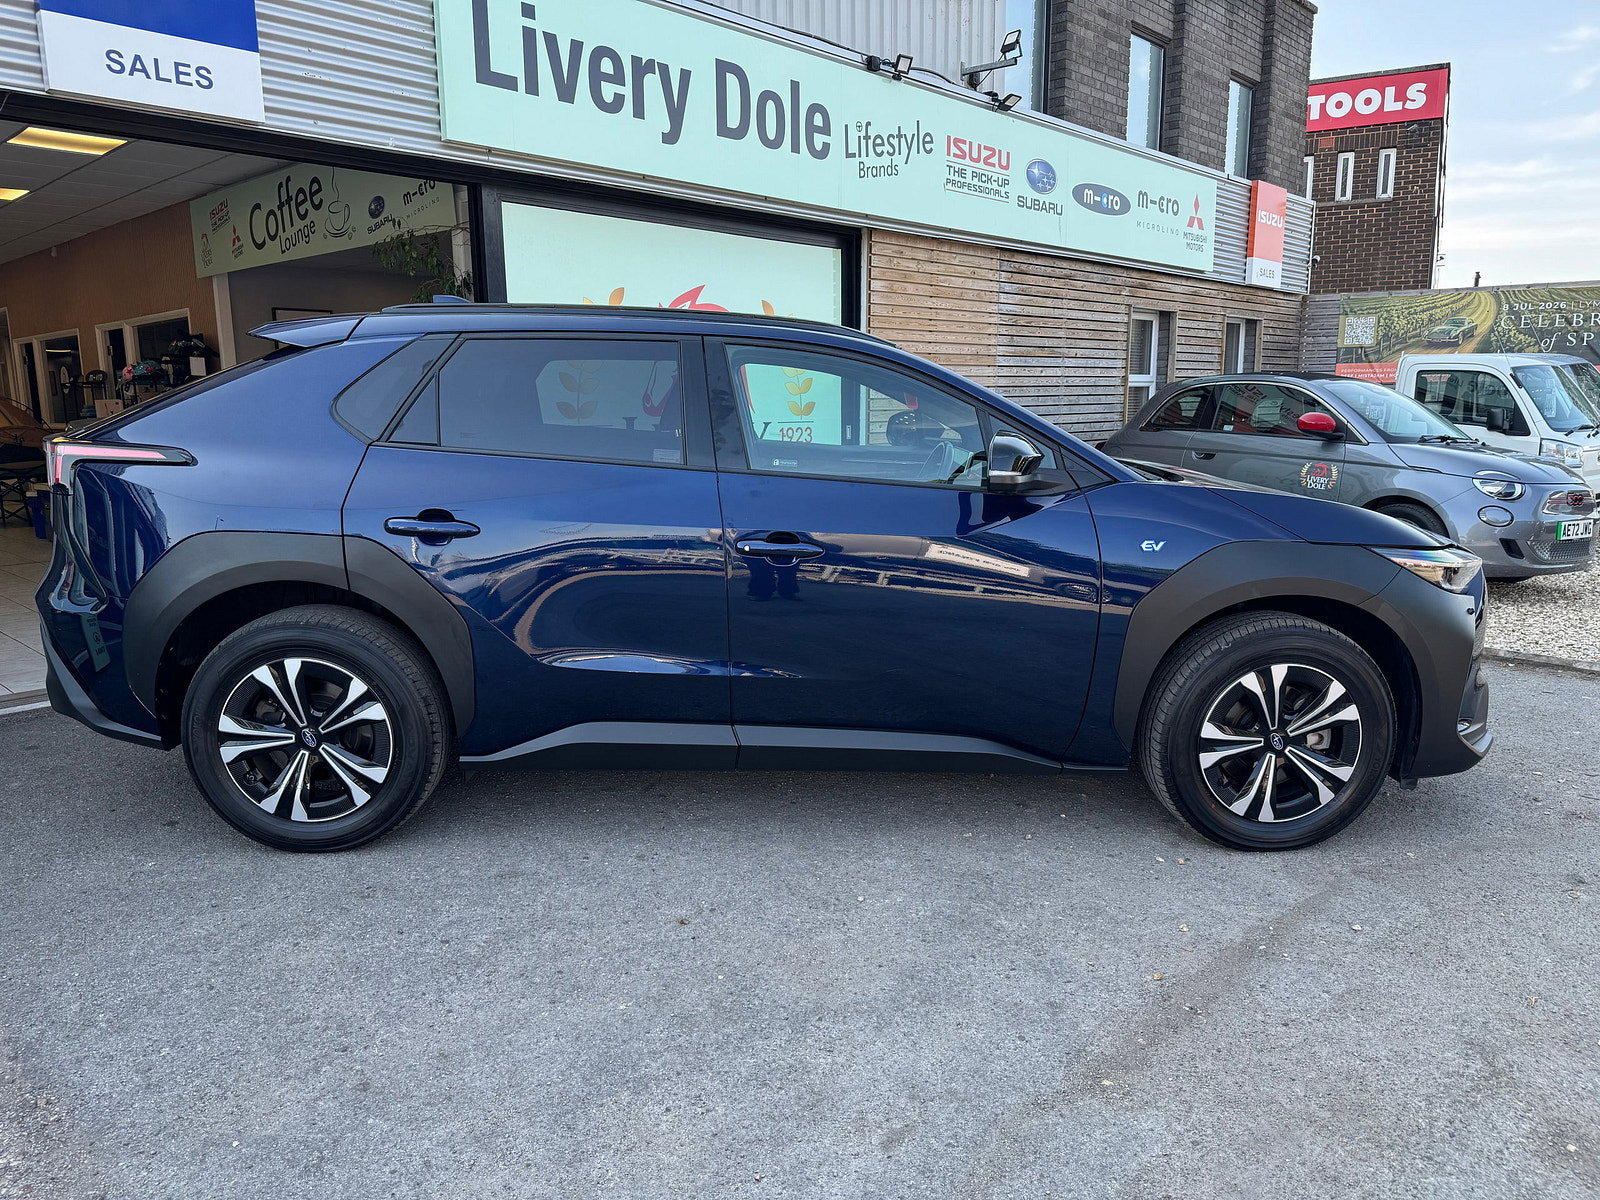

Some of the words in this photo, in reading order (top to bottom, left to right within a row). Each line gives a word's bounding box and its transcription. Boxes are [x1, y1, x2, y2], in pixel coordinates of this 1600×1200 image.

[105, 49, 214, 90] SALES
[472, 0, 692, 145] Livery
[715, 58, 831, 160] Dole
[1307, 82, 1427, 120] TOOLS
[844, 120, 934, 165] Lifestyle
[946, 135, 1011, 171] ISUZU
[858, 158, 899, 179] Brands
[946, 164, 967, 179] THE
[971, 171, 1010, 189] PICK-UP
[946, 178, 1010, 199] PROFESSIONALS
[209, 198, 229, 220] ISUZU
[249, 175, 324, 250] Coffee
[1017, 195, 1063, 216] SUBARU
[367, 213, 393, 235] SUBARU
[1136, 220, 1180, 236] MICROLINO
[1257, 210, 1283, 228] ISUZU
[279, 220, 316, 254] Lounge
[1183, 231, 1208, 244] MITSUBISHI
[1186, 242, 1204, 253] MOTORS
[1258, 267, 1275, 280] SALES
[1513, 302, 1535, 311] JUL
[1538, 301, 1567, 310] 2026
[1501, 312, 1600, 329] CELEBR
[1541, 332, 1561, 353] of
[1566, 332, 1595, 347] SP
[779, 426, 813, 444] 1923
[1307, 475, 1329, 484] LIVERY
[1307, 480, 1326, 490] DOLE
[1562, 523, 1580, 537] AE72
[1140, 540, 1167, 551] EV
